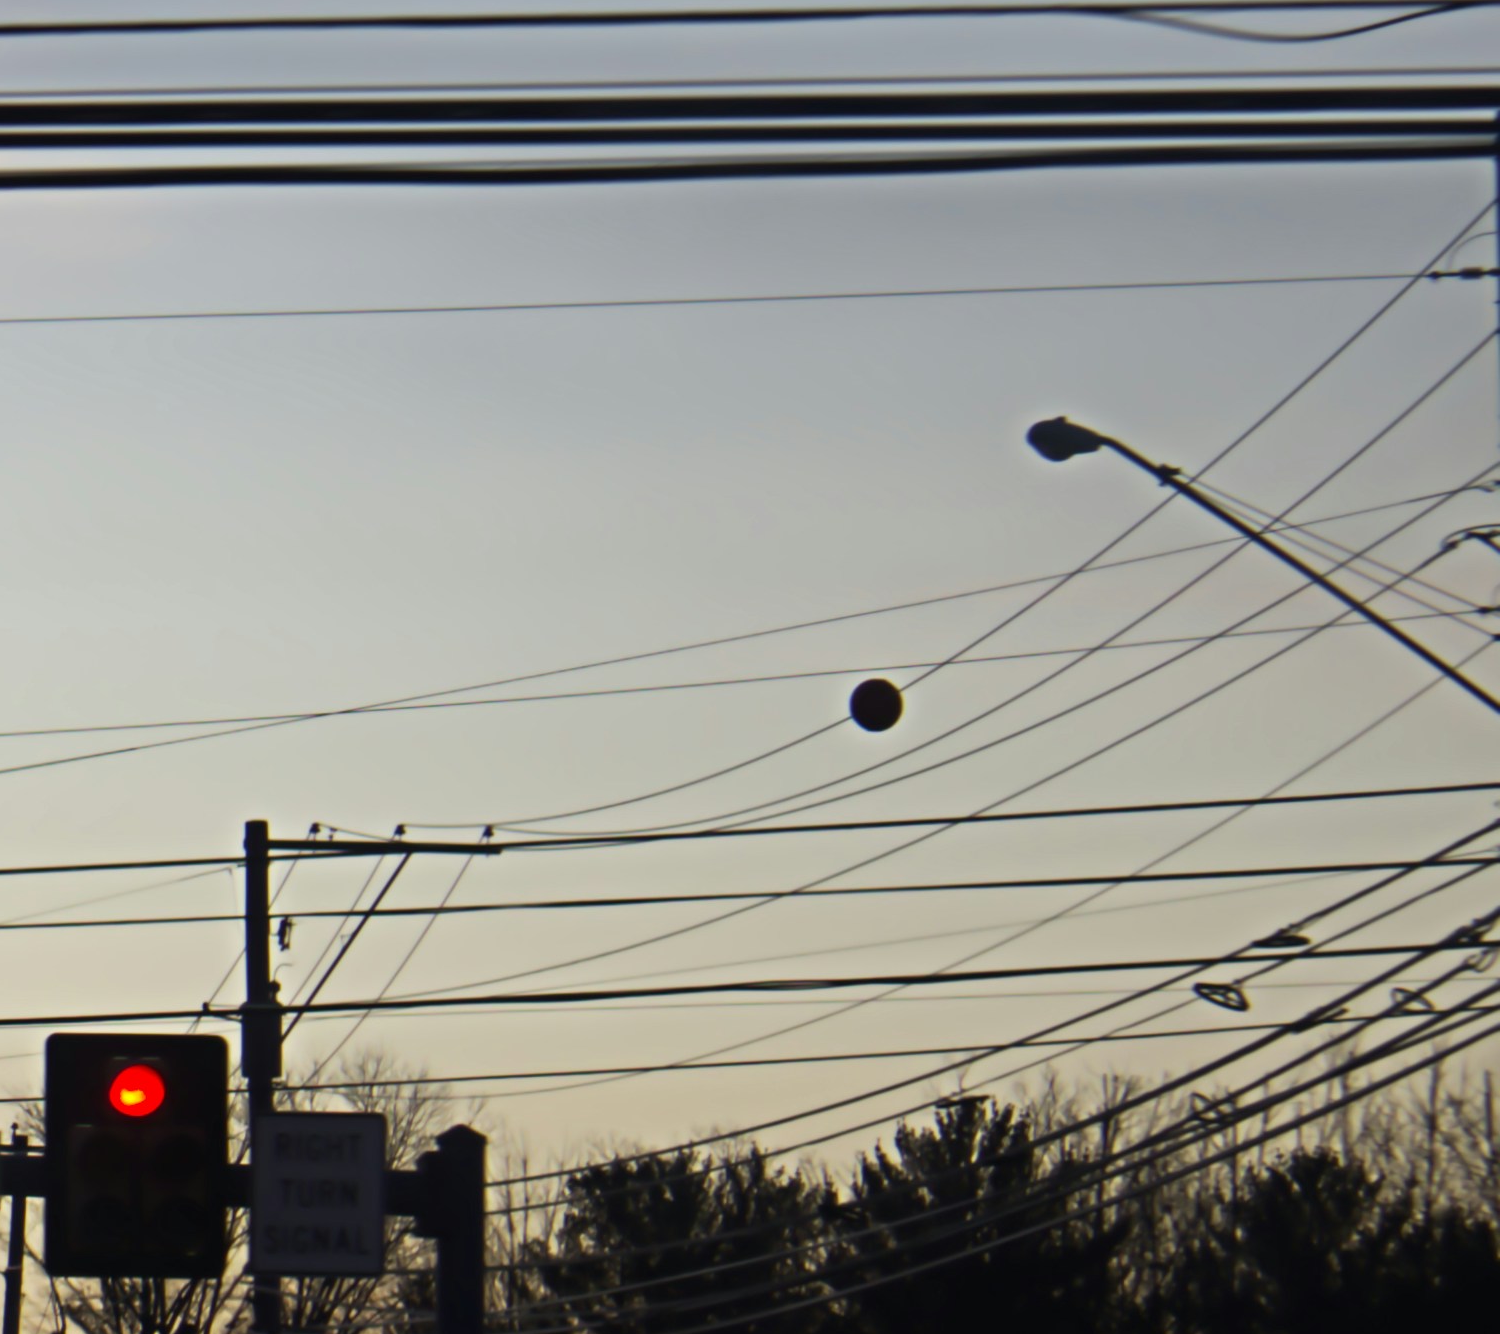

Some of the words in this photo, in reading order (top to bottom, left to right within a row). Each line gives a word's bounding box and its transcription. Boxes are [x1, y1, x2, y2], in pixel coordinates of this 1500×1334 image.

[274, 1132, 362, 1161] RIGHT
[280, 1179, 359, 1209] TURN
[263, 1224, 370, 1255] SIGNAL
